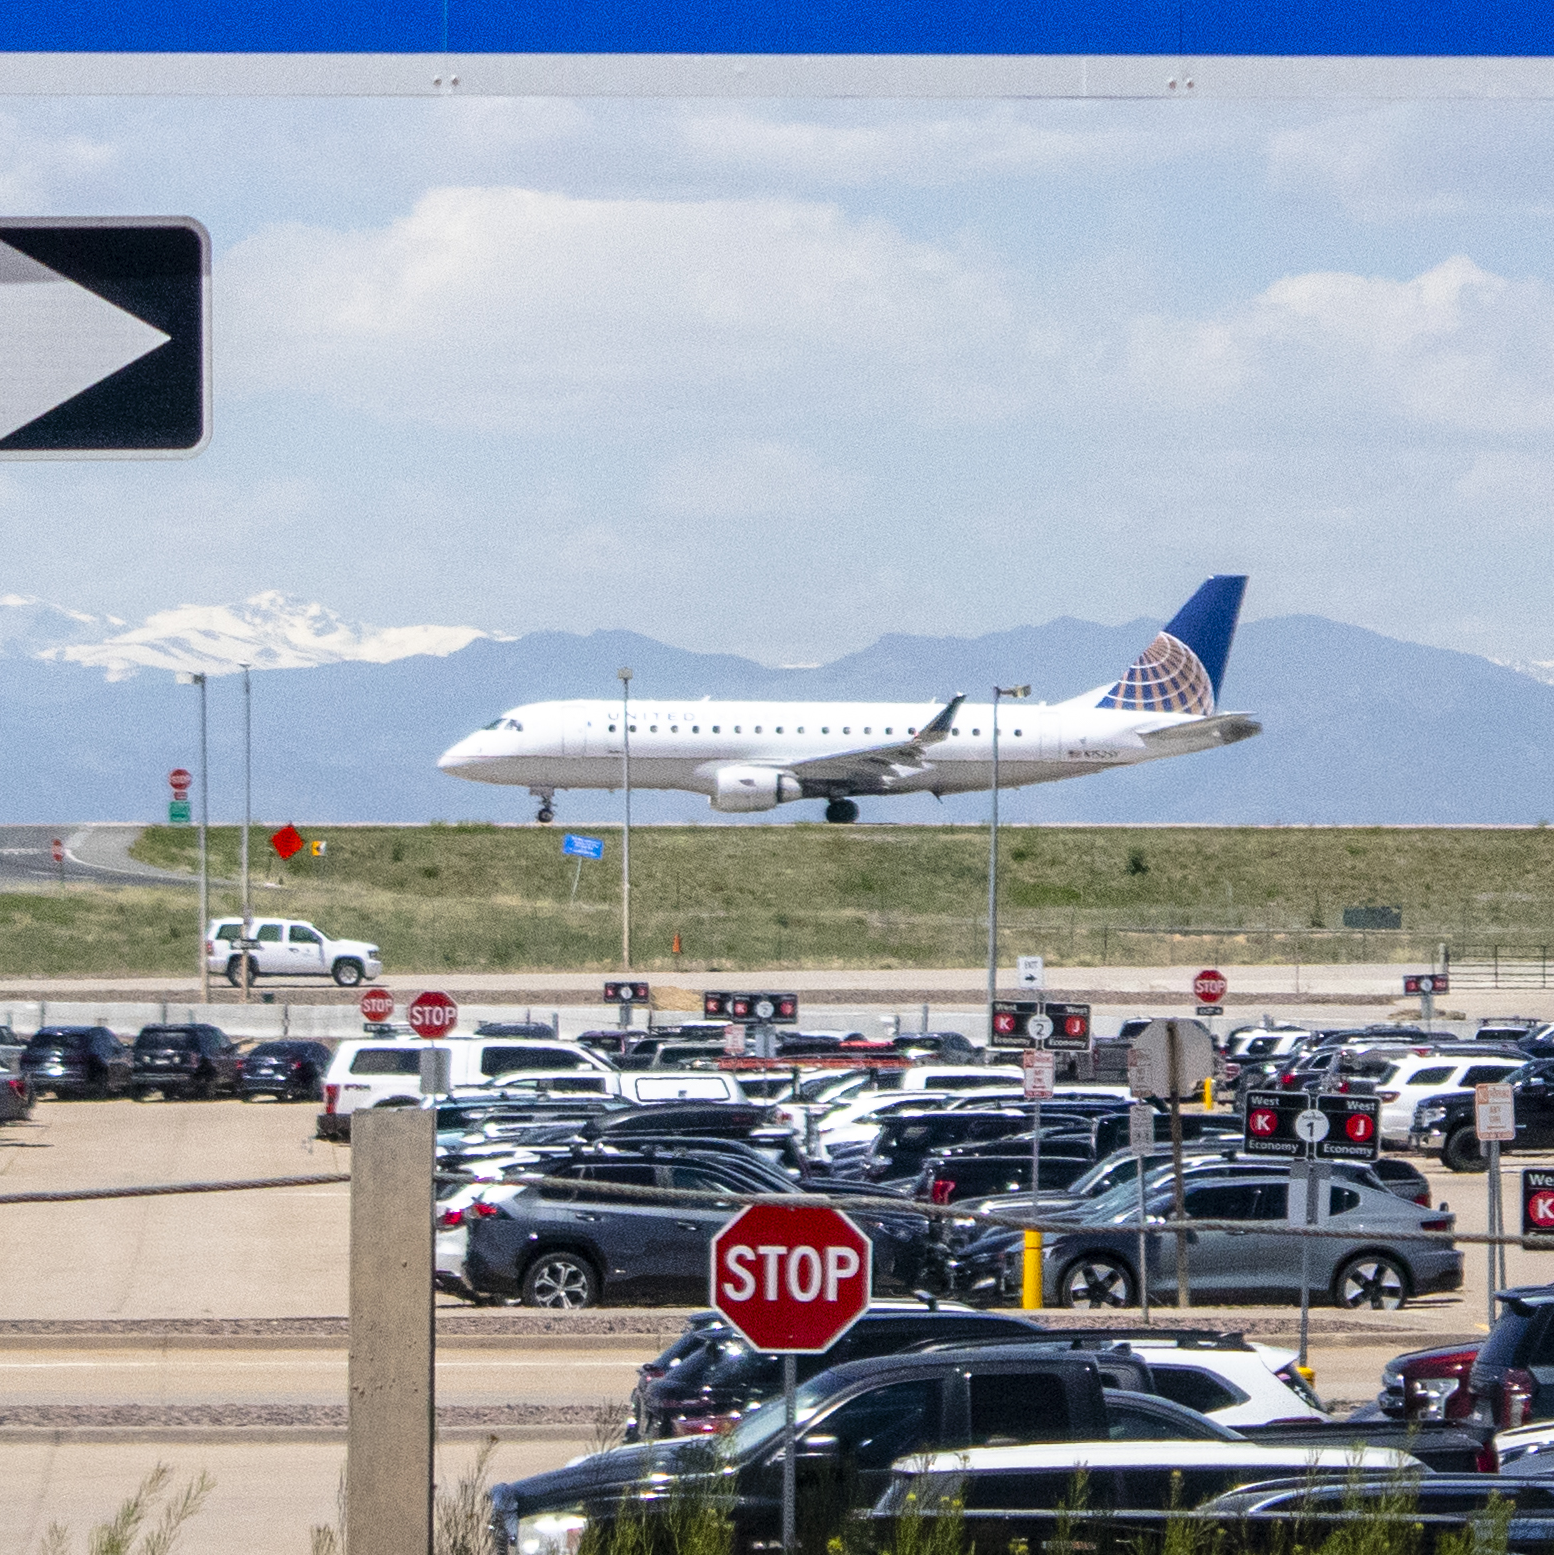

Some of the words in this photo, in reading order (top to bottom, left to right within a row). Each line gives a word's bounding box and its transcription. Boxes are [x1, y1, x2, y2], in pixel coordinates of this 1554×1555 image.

[607, 712, 695, 721] UNITED
[1024, 961, 1038, 969] EXIT
[1195, 979, 1226, 993] STOP
[362, 999, 393, 1013] STOP
[412, 1006, 457, 1025] STOP
[1000, 1017, 1010, 1030] K
[1035, 1024, 1044, 1036] 2
[1072, 1020, 1080, 1032] J
[1251, 1096, 1280, 1106] West
[1346, 1101, 1375, 1111] West
[1256, 1115, 1271, 1131] K
[1306, 1122, 1314, 1137] 1
[1354, 1119, 1365, 1136] J
[1248, 1140, 1299, 1153] Economy
[1323, 1143, 1374, 1157] Economy
[1537, 1198, 1554, 1219] K
[724, 1245, 860, 1302] STOP
